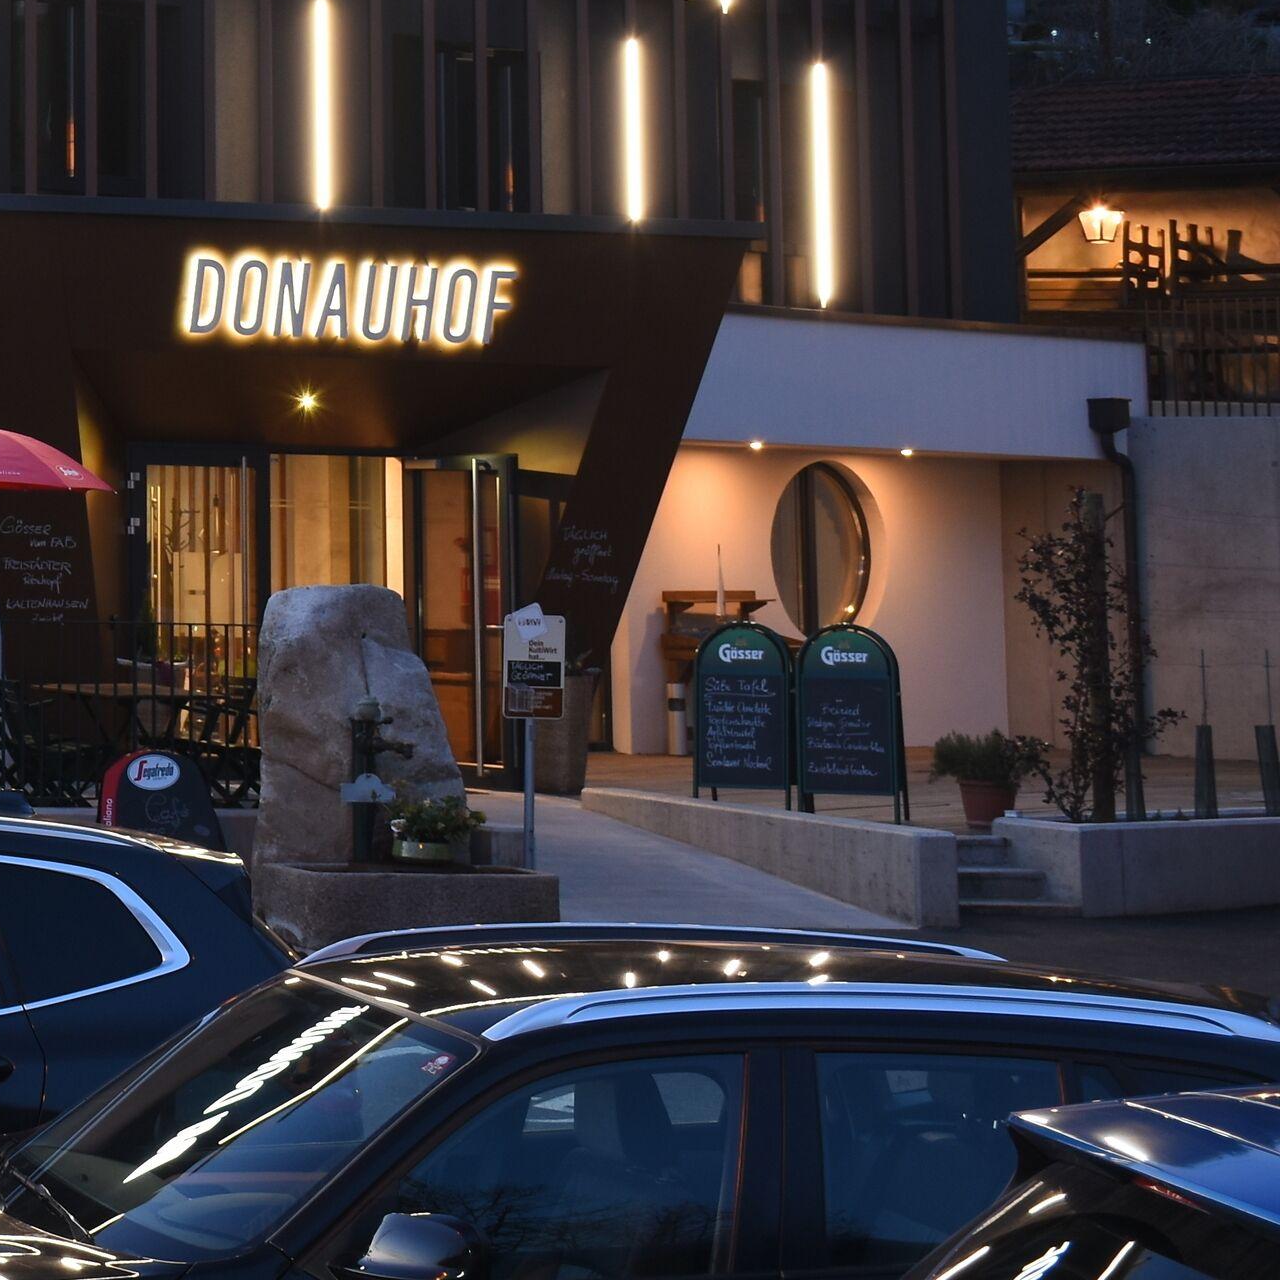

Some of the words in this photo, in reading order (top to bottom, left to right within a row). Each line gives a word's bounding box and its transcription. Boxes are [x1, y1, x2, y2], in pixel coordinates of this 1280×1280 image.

[189, 257, 519, 345] DONAUHOF
[718, 643, 765, 663] Gösser
[820, 645, 869, 666] Gösser
[133, 760, 175, 782] Segafredo
[103, 798, 113, 826] aliano
